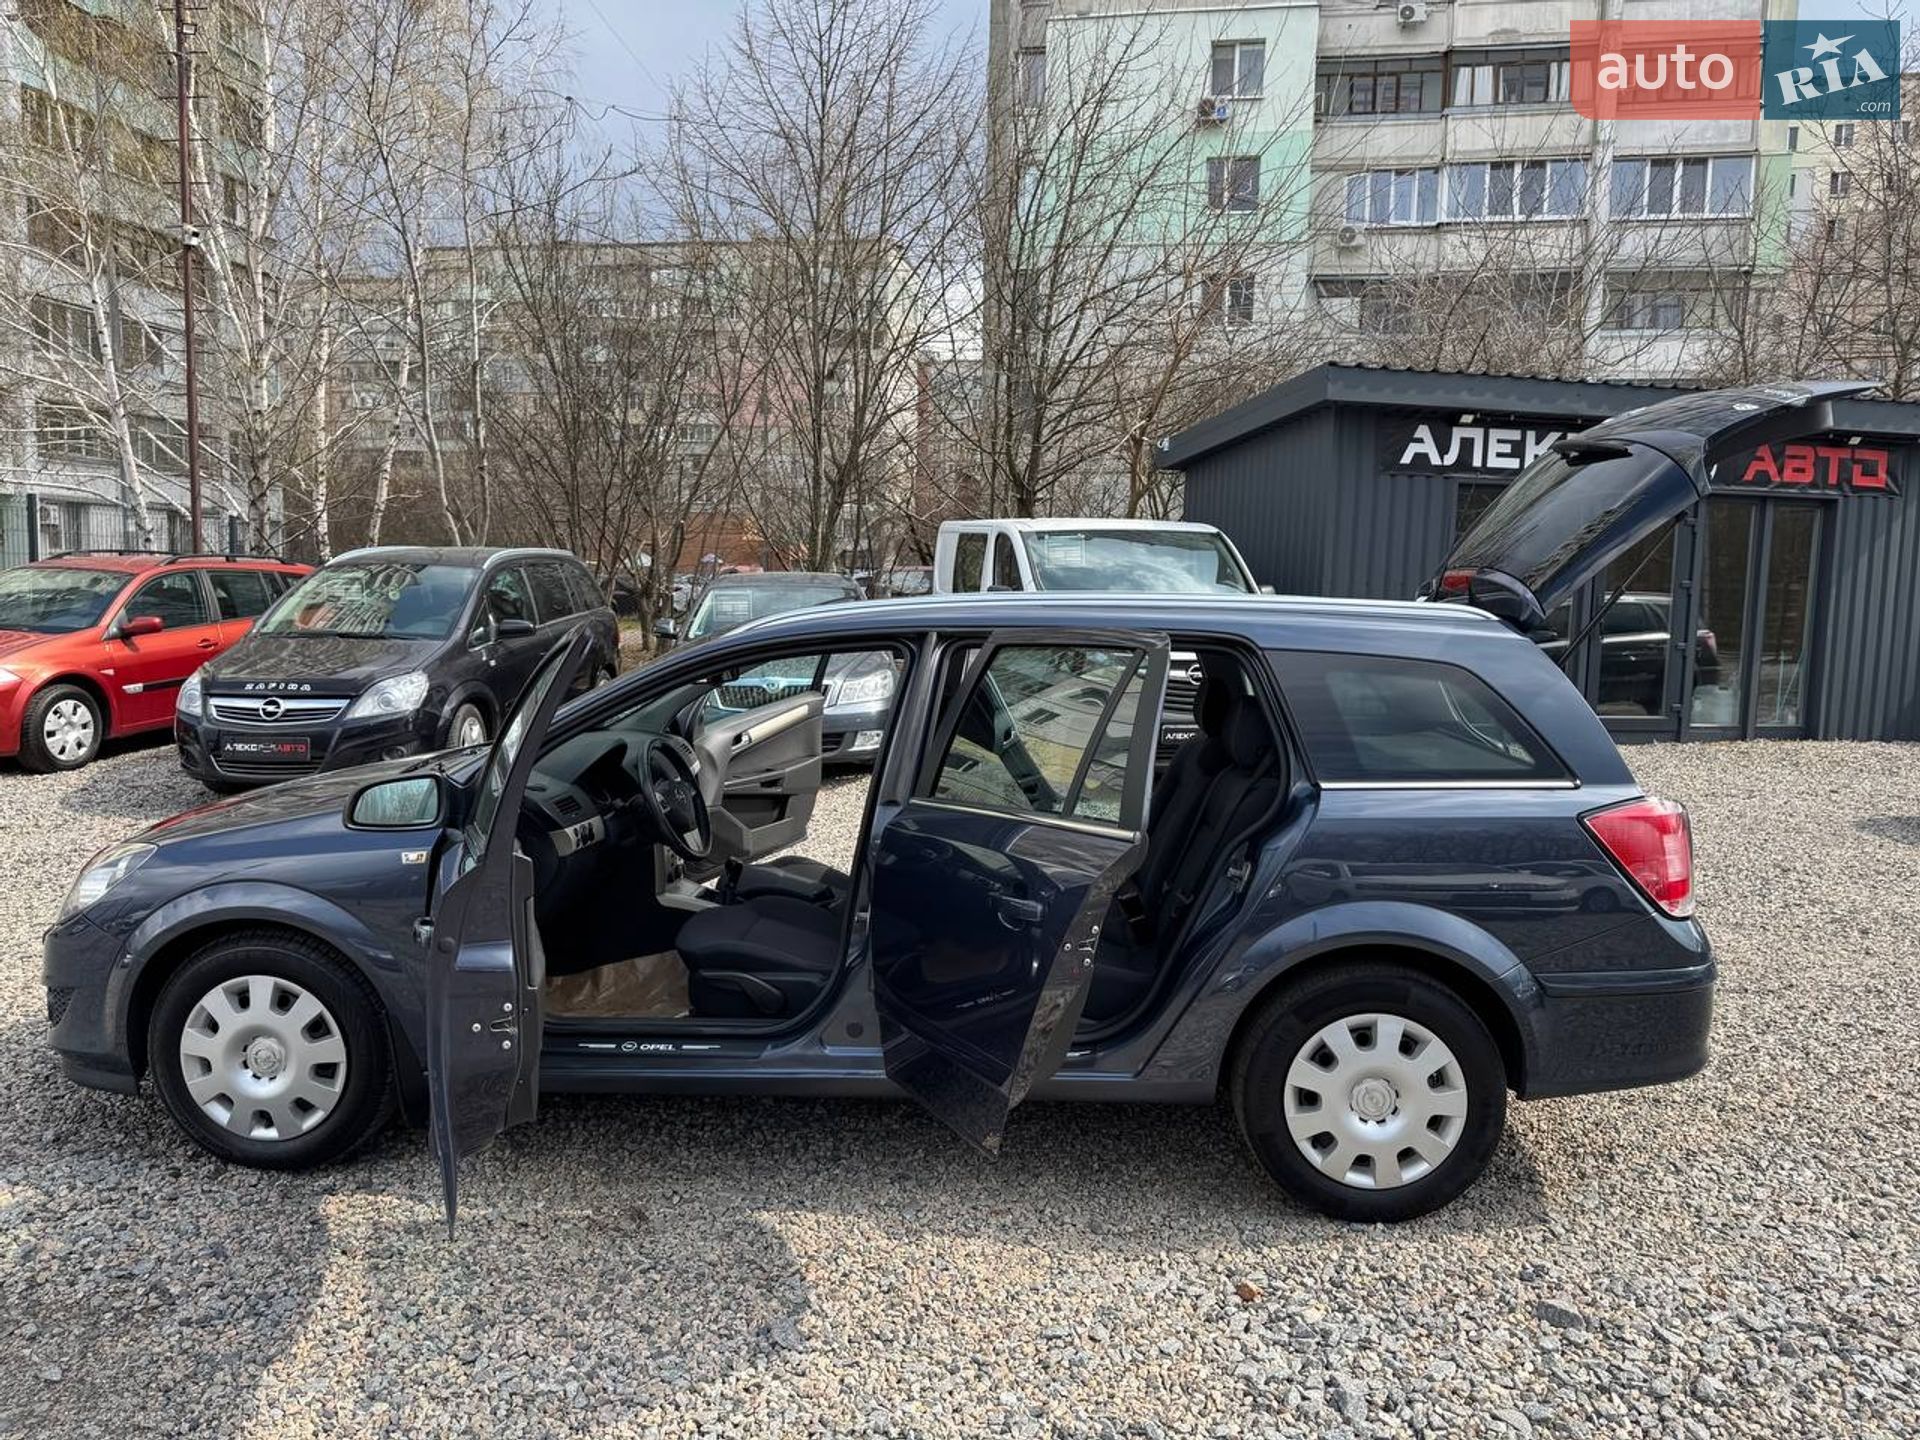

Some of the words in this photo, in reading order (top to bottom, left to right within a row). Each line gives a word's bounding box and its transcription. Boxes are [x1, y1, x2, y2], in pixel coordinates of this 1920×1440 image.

[1400, 424, 1580, 469] АЛЕК
[1743, 443, 1888, 488] АВТО
[640, 1043, 676, 1051] OPEL
